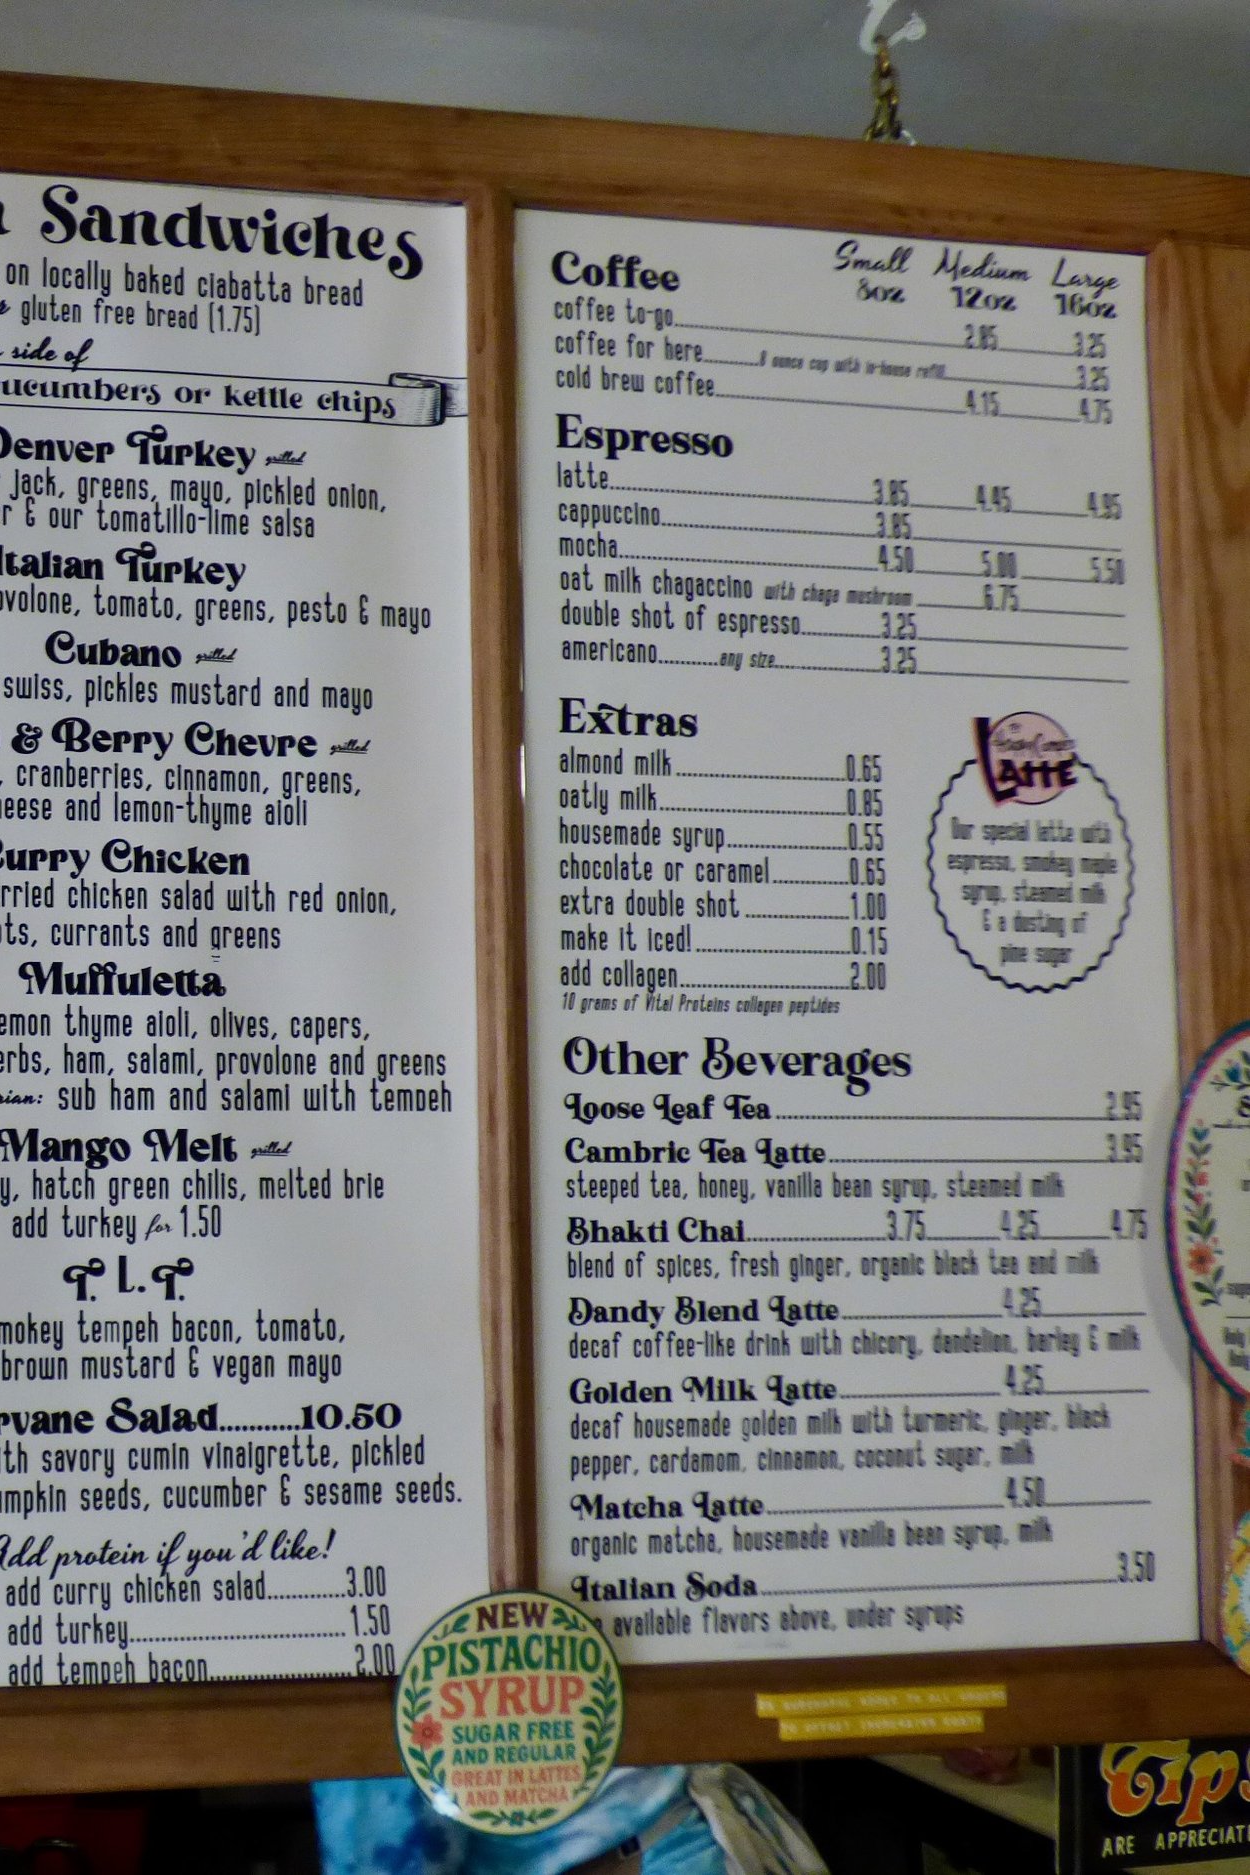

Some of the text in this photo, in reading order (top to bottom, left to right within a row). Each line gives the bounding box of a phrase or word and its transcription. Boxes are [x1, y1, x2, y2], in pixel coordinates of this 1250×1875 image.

[40, 185, 423, 280] Sandwiches
[6, 263, 29, 286] on
[43, 257, 111, 297] locally
[125, 262, 184, 296] baked
[198, 270, 291, 303] ciabatta
[304, 276, 363, 306] bread
[551, 251, 680, 292] Coffee
[834, 240, 1118, 299] Small Medium Large
[554, 296, 614, 322] coffee
[12, 336, 58, 361] side
[174, 385, 211, 404] or
[224, 384, 303, 409] kettle
[317, 390, 397, 422] chips
[126, 424, 256, 475] Turkey
[556, 413, 734, 460] Espresso
[115, 541, 246, 592] Turkey
[45, 630, 182, 668] Cubano
[559, 697, 698, 737] Extras
[11, 723, 43, 754] &
[51, 717, 174, 761] Berry
[184, 721, 317, 757] Chevre
[560, 746, 623, 774] almond
[101, 839, 250, 875] Chicken
[18, 962, 227, 997] Muffuletta
[563, 1036, 912, 1097] Other Beverages
[564, 1093, 772, 1125] Loose Leaf Tea
[143, 1129, 238, 1162] Melt
[565, 1137, 826, 1169] Cambric Tea Latte
[567, 1217, 670, 1245] Bhakti
[568, 1295, 839, 1330] Dandy Blend Latte
[569, 1375, 842, 1406] Golden Milk Latte
[570, 1491, 769, 1523] Matcha Latte
[50, 1539, 149, 1580] protein
[156, 1531, 186, 1577] if
[188, 1529, 268, 1577] you'd
[270, 1528, 336, 1562] like!
[570, 1576, 676, 1605] Italian
[476, 1601, 549, 1632] NEW
[422, 1634, 601, 1682] PISTACHIO
[439, 1676, 585, 1720] SYRUP
[452, 1721, 575, 1744] SUGAR FREE
[452, 1744, 576, 1766] AND REGULAR
[451, 1765, 581, 1788] GREAT IN LATTES
[465, 1786, 568, 1807] AND MATCHA
[1101, 1835, 1136, 1858] ARE
